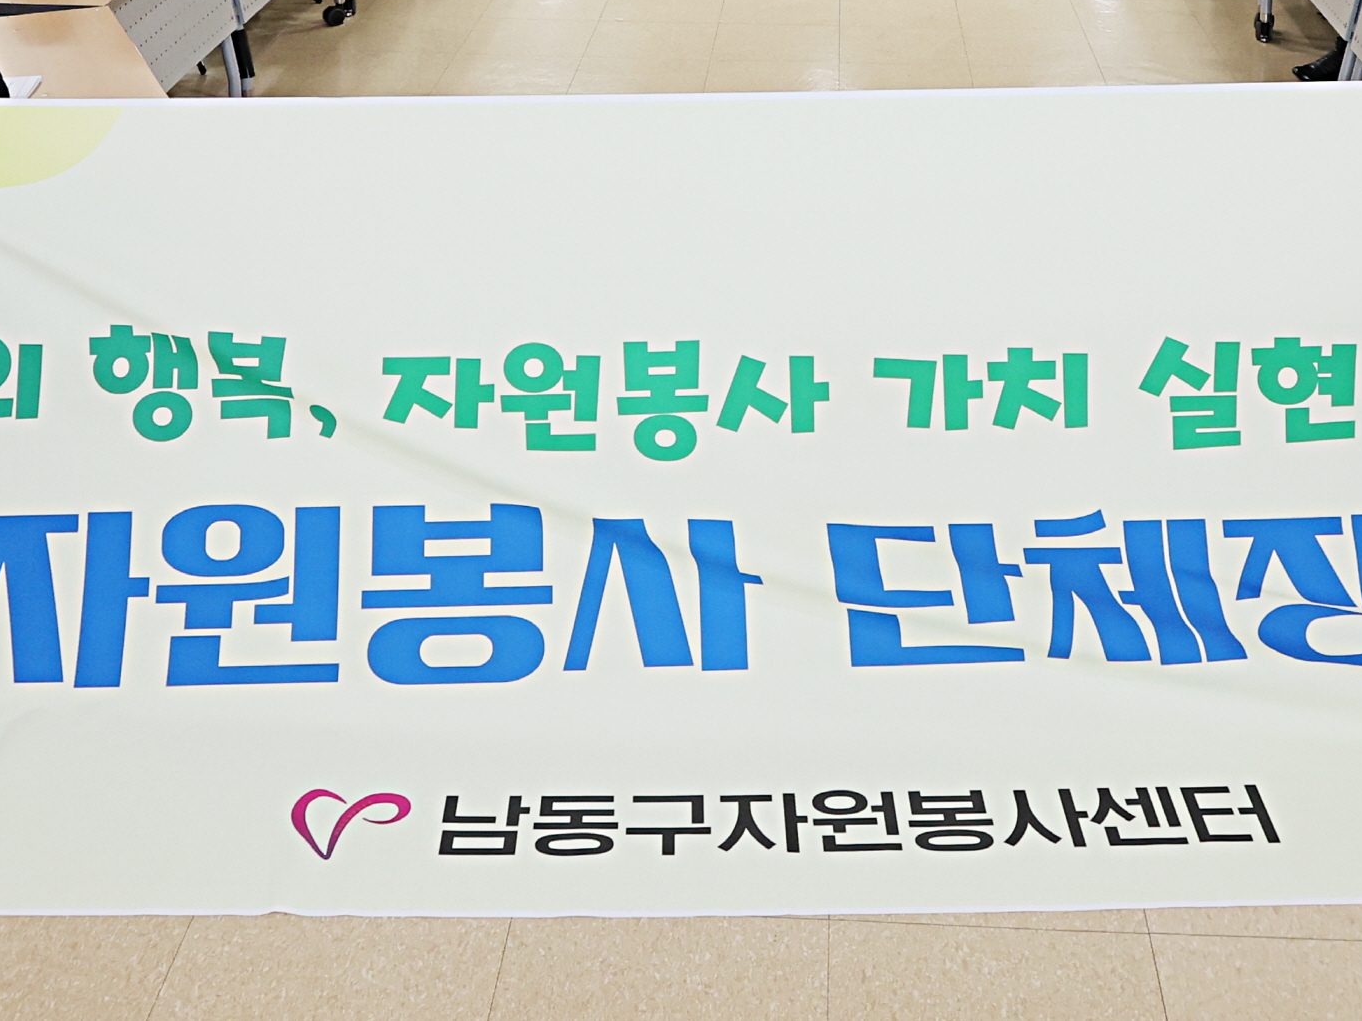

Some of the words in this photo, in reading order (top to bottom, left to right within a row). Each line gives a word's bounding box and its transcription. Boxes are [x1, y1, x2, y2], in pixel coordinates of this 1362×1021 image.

[89, 324, 337, 442] 행복,
[382, 340, 830, 462] 자원봉사
[873, 347, 1089, 431] 가치
[438, 783, 1281, 857] 남동구자원봉사센터
